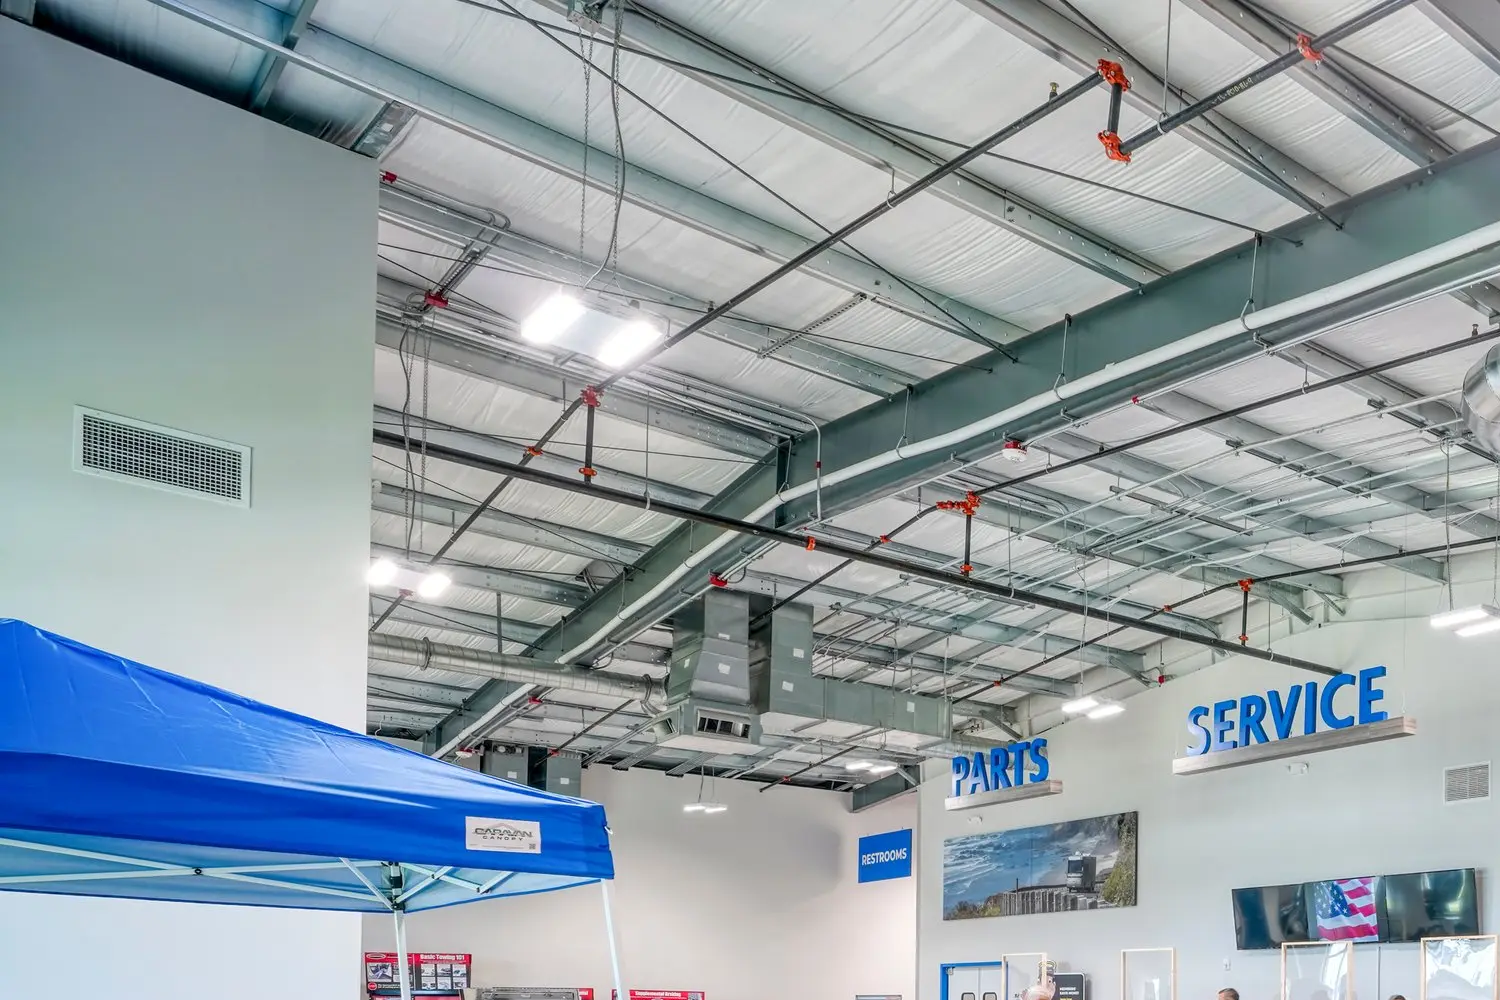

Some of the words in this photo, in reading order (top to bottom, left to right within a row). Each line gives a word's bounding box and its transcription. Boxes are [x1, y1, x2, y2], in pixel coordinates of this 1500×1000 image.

[1186, 665, 1388, 756] SERVICE
[951, 737, 1050, 797] PARTS
[861, 847, 908, 866] RESTROOMS
